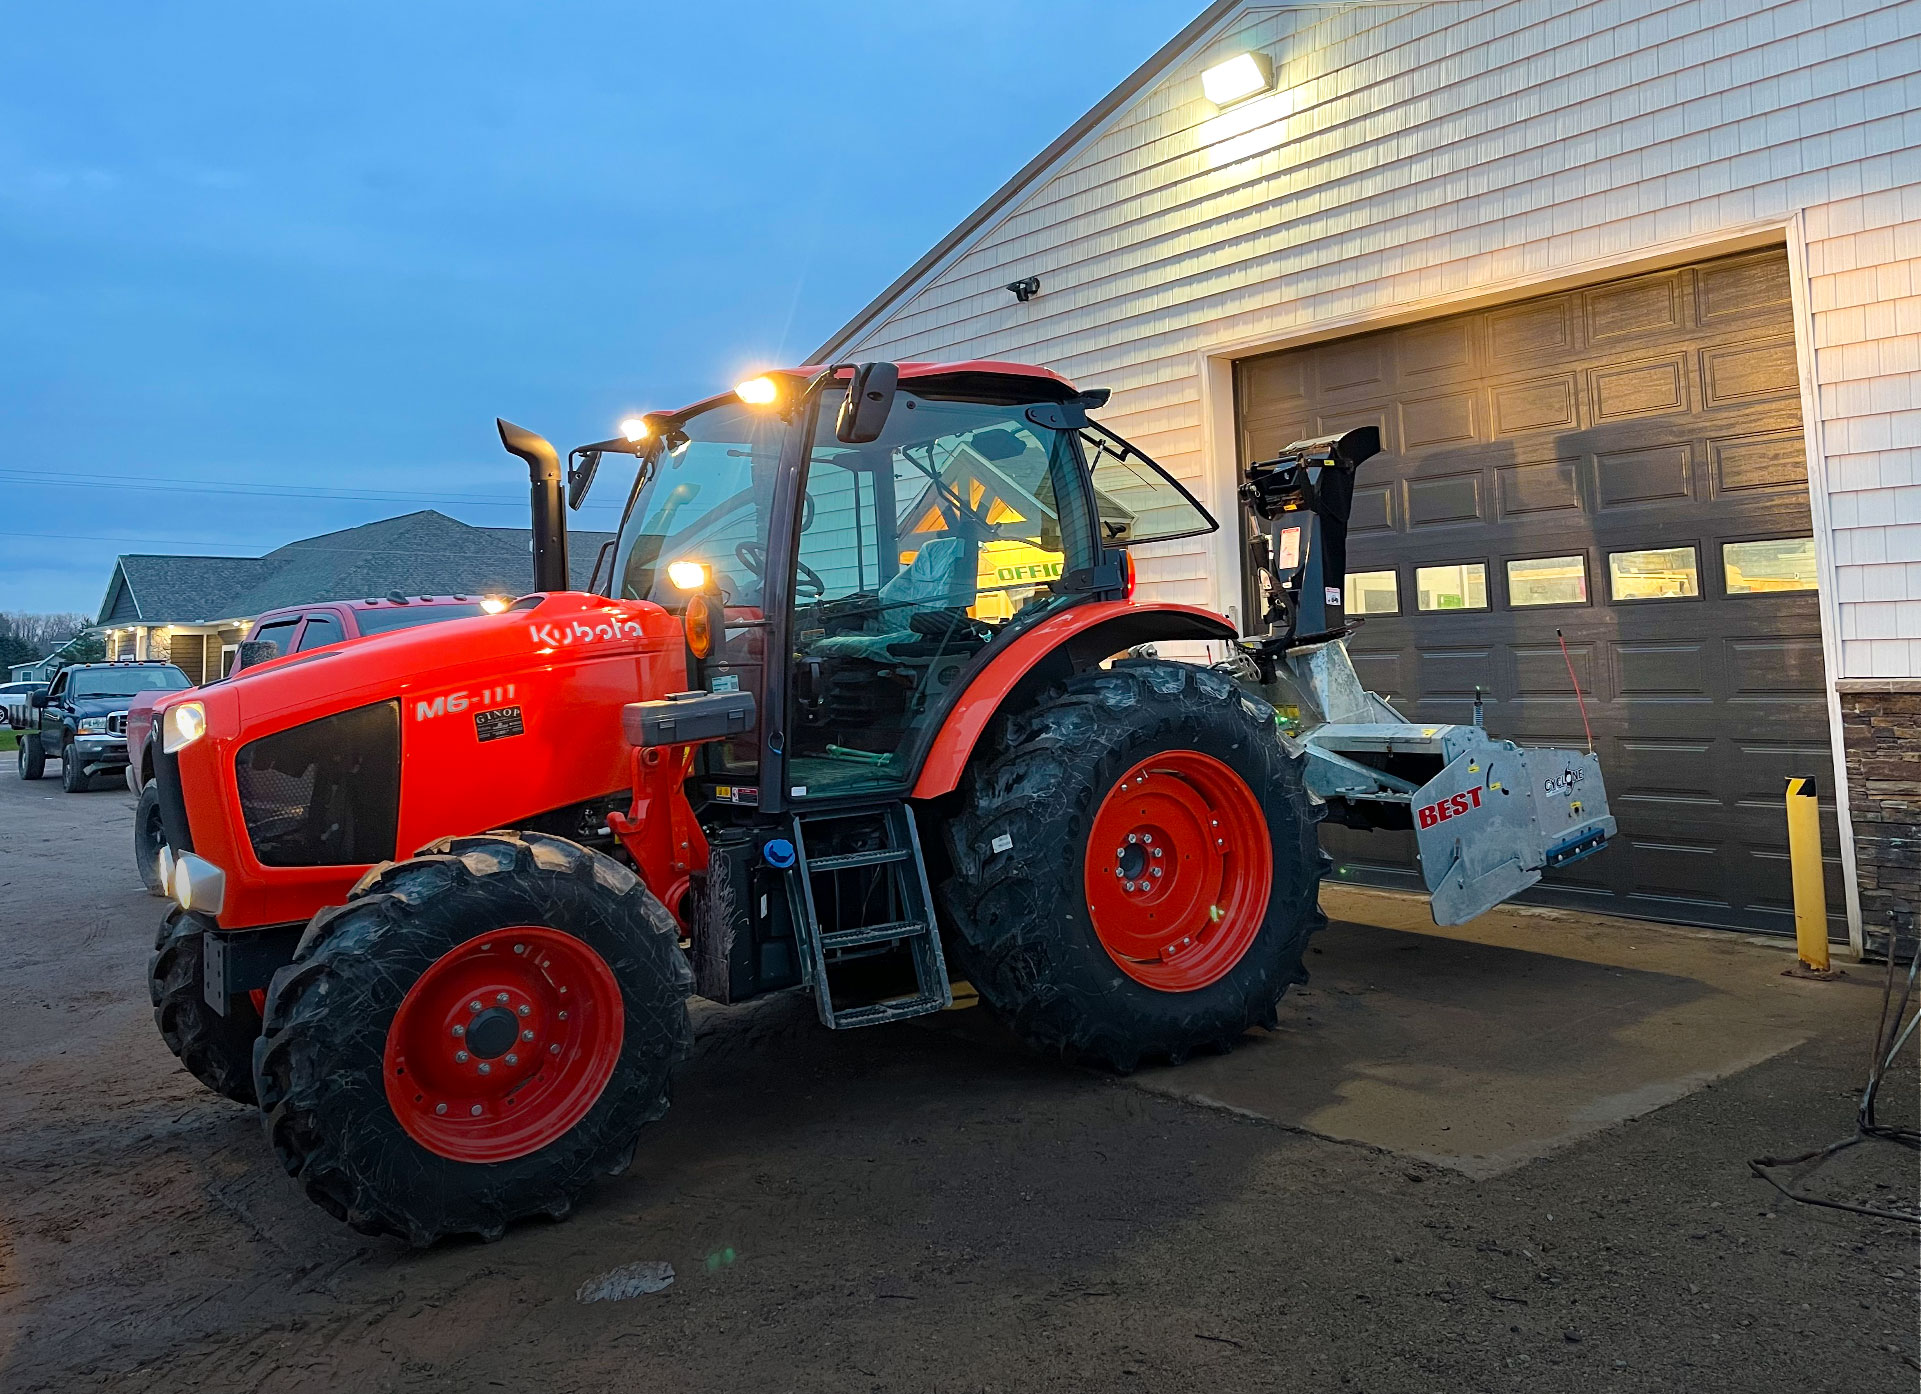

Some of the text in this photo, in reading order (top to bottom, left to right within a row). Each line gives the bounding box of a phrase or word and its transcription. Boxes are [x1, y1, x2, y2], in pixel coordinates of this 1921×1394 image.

[529, 617, 643, 646] Kubota
[416, 684, 515, 722] M6-111
[1544, 766, 1585, 793] CYCLONE
[1417, 785, 1483, 831] BEST
